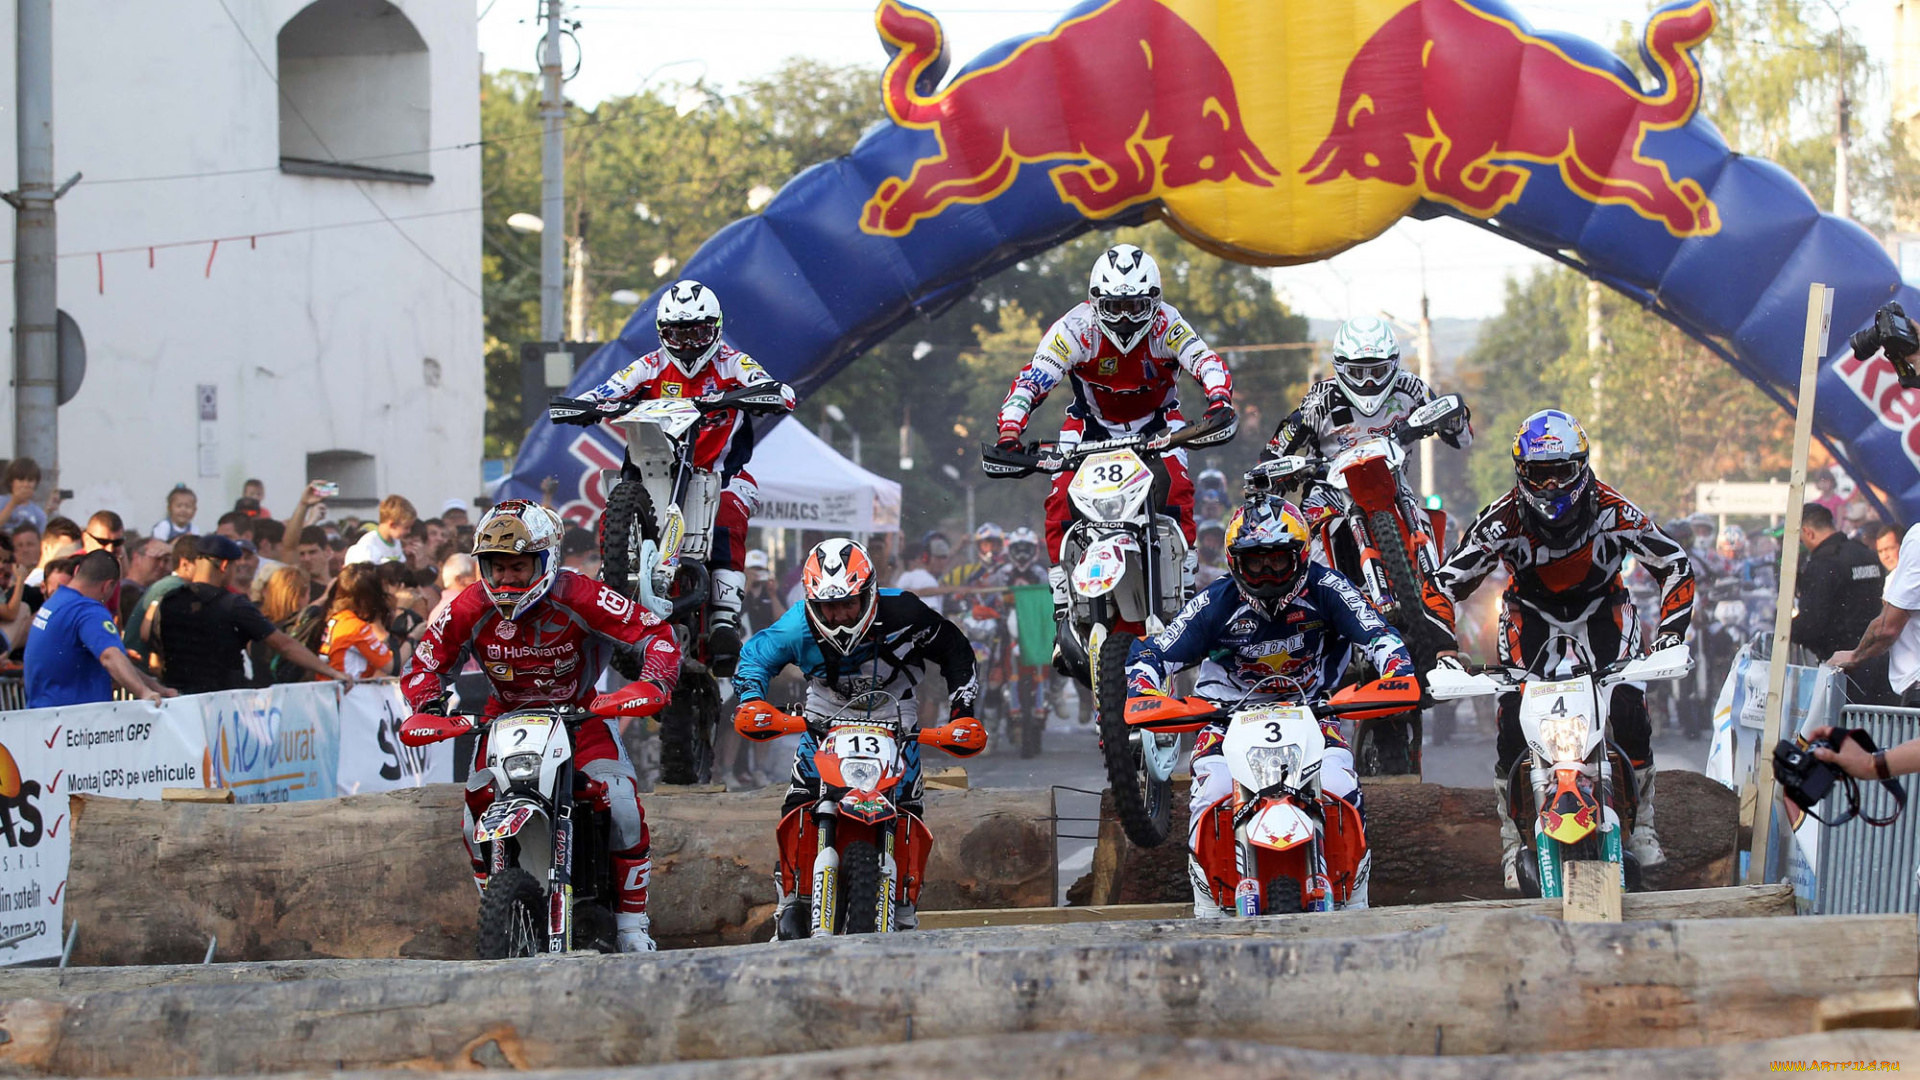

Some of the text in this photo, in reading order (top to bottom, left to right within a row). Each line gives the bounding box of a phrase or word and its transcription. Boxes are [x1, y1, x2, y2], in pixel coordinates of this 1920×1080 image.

[1093, 464, 1123, 484] 38
[504, 641, 574, 659] Husqvarna
[1378, 680, 1410, 690] KTM
[622, 697, 649, 709] HYDE
[1130, 699, 1162, 712] KTM
[1551, 696, 1568, 718] 4
[66, 722, 152, 749] Echipament GPS
[408, 727, 436, 737] HYDE
[512, 728, 528, 747] 2
[1264, 721, 1283, 743] 3
[848, 735, 880, 755] 13
[67, 762, 196, 794] Montaj GPS pe vehicule
[1540, 846, 1556, 888] Mitas
[14, 880, 41, 910] satelit
[812, 873, 824, 929] ROCK OIL
[825, 873, 835, 928] GoldenTyre
